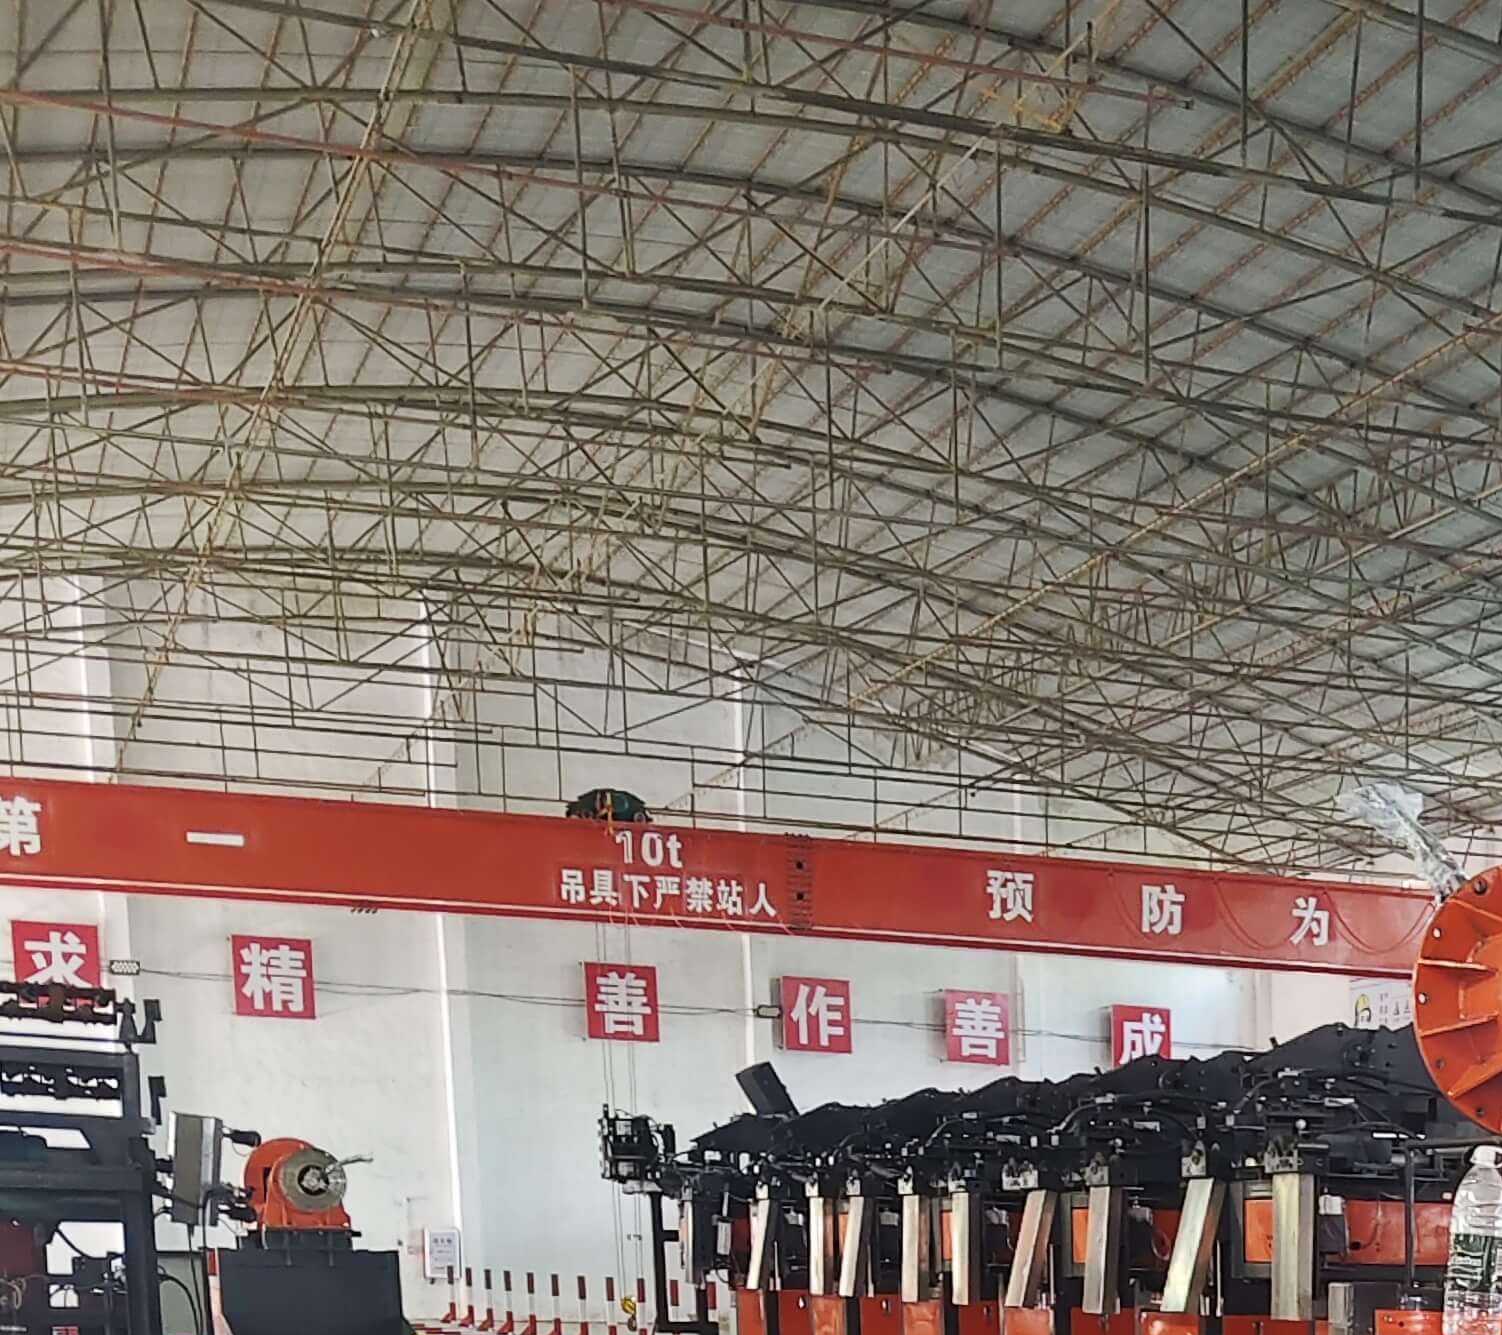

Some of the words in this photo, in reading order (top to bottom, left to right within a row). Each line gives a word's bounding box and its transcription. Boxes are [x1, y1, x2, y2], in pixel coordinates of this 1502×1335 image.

[0, 796, 42, 857] 第
[186, 831, 245, 846] 一
[615, 830, 684, 869] 10t
[560, 868, 777, 917] 吊具下严禁站人
[985, 869, 1035, 923] 预
[1141, 883, 1186, 935] 防
[1290, 896, 1331, 946] 为
[239, 942, 308, 1013] 精
[594, 971, 652, 1036] 善
[790, 983, 846, 1048] 作
[951, 997, 1005, 1060] 善
